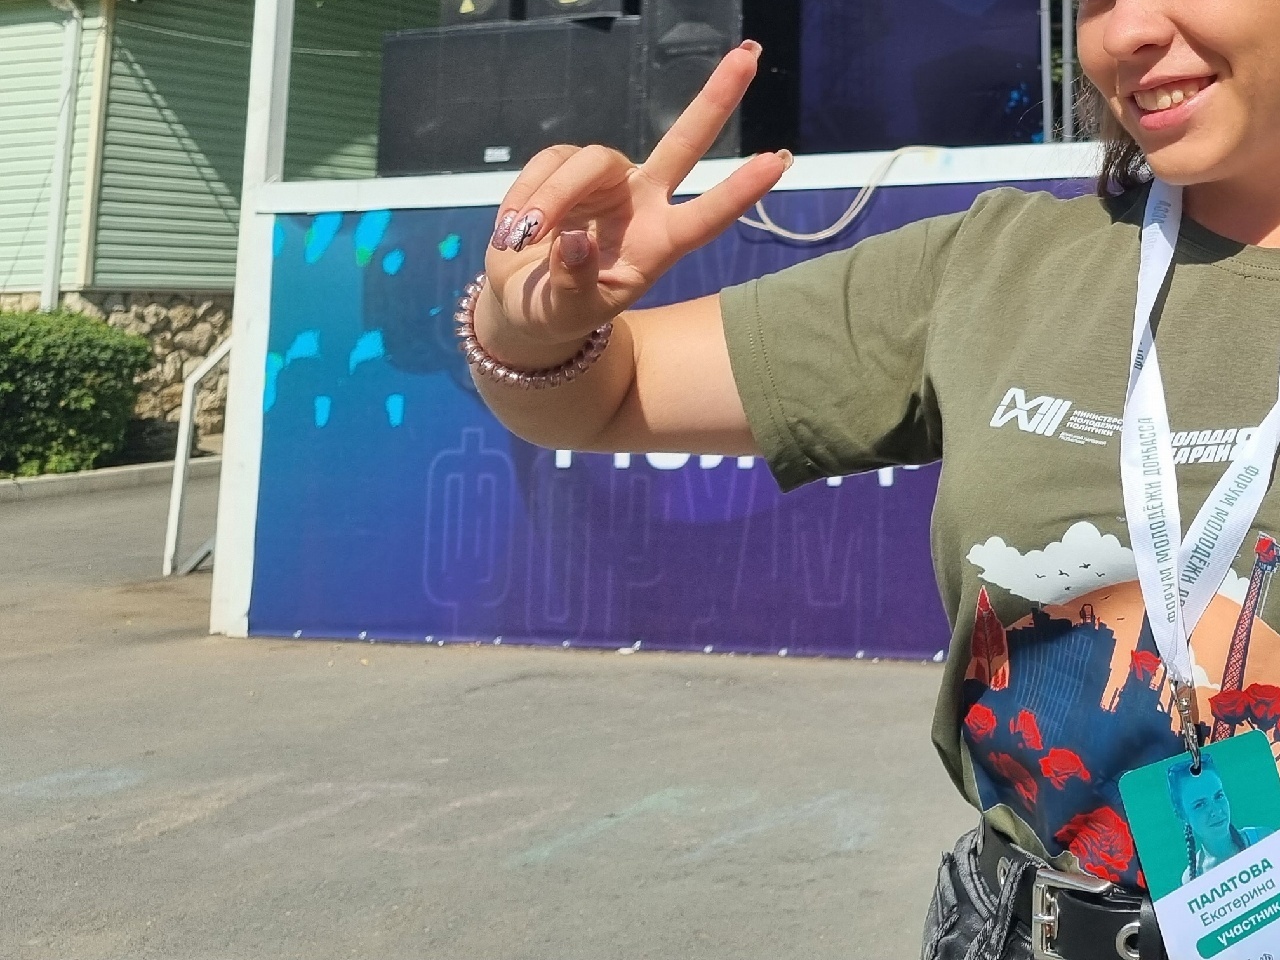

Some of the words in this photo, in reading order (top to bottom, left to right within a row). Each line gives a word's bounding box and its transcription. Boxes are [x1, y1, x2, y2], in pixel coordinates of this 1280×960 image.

[1073, 409, 1123, 425] МИНИСТЕРС
[1137, 417, 1162, 476] ДОНБАССА
[1221, 465, 1260, 509] ФОРУМ
[1143, 481, 1172, 565] МОЛОДЁЖИ
[1181, 507, 1230, 588] МОЛОДЁЖИ
[1160, 567, 1177, 624] ФОРУМ
[1187, 857, 1273, 914] ПАЛАТОВА
[1200, 878, 1276, 927] Екатерина
